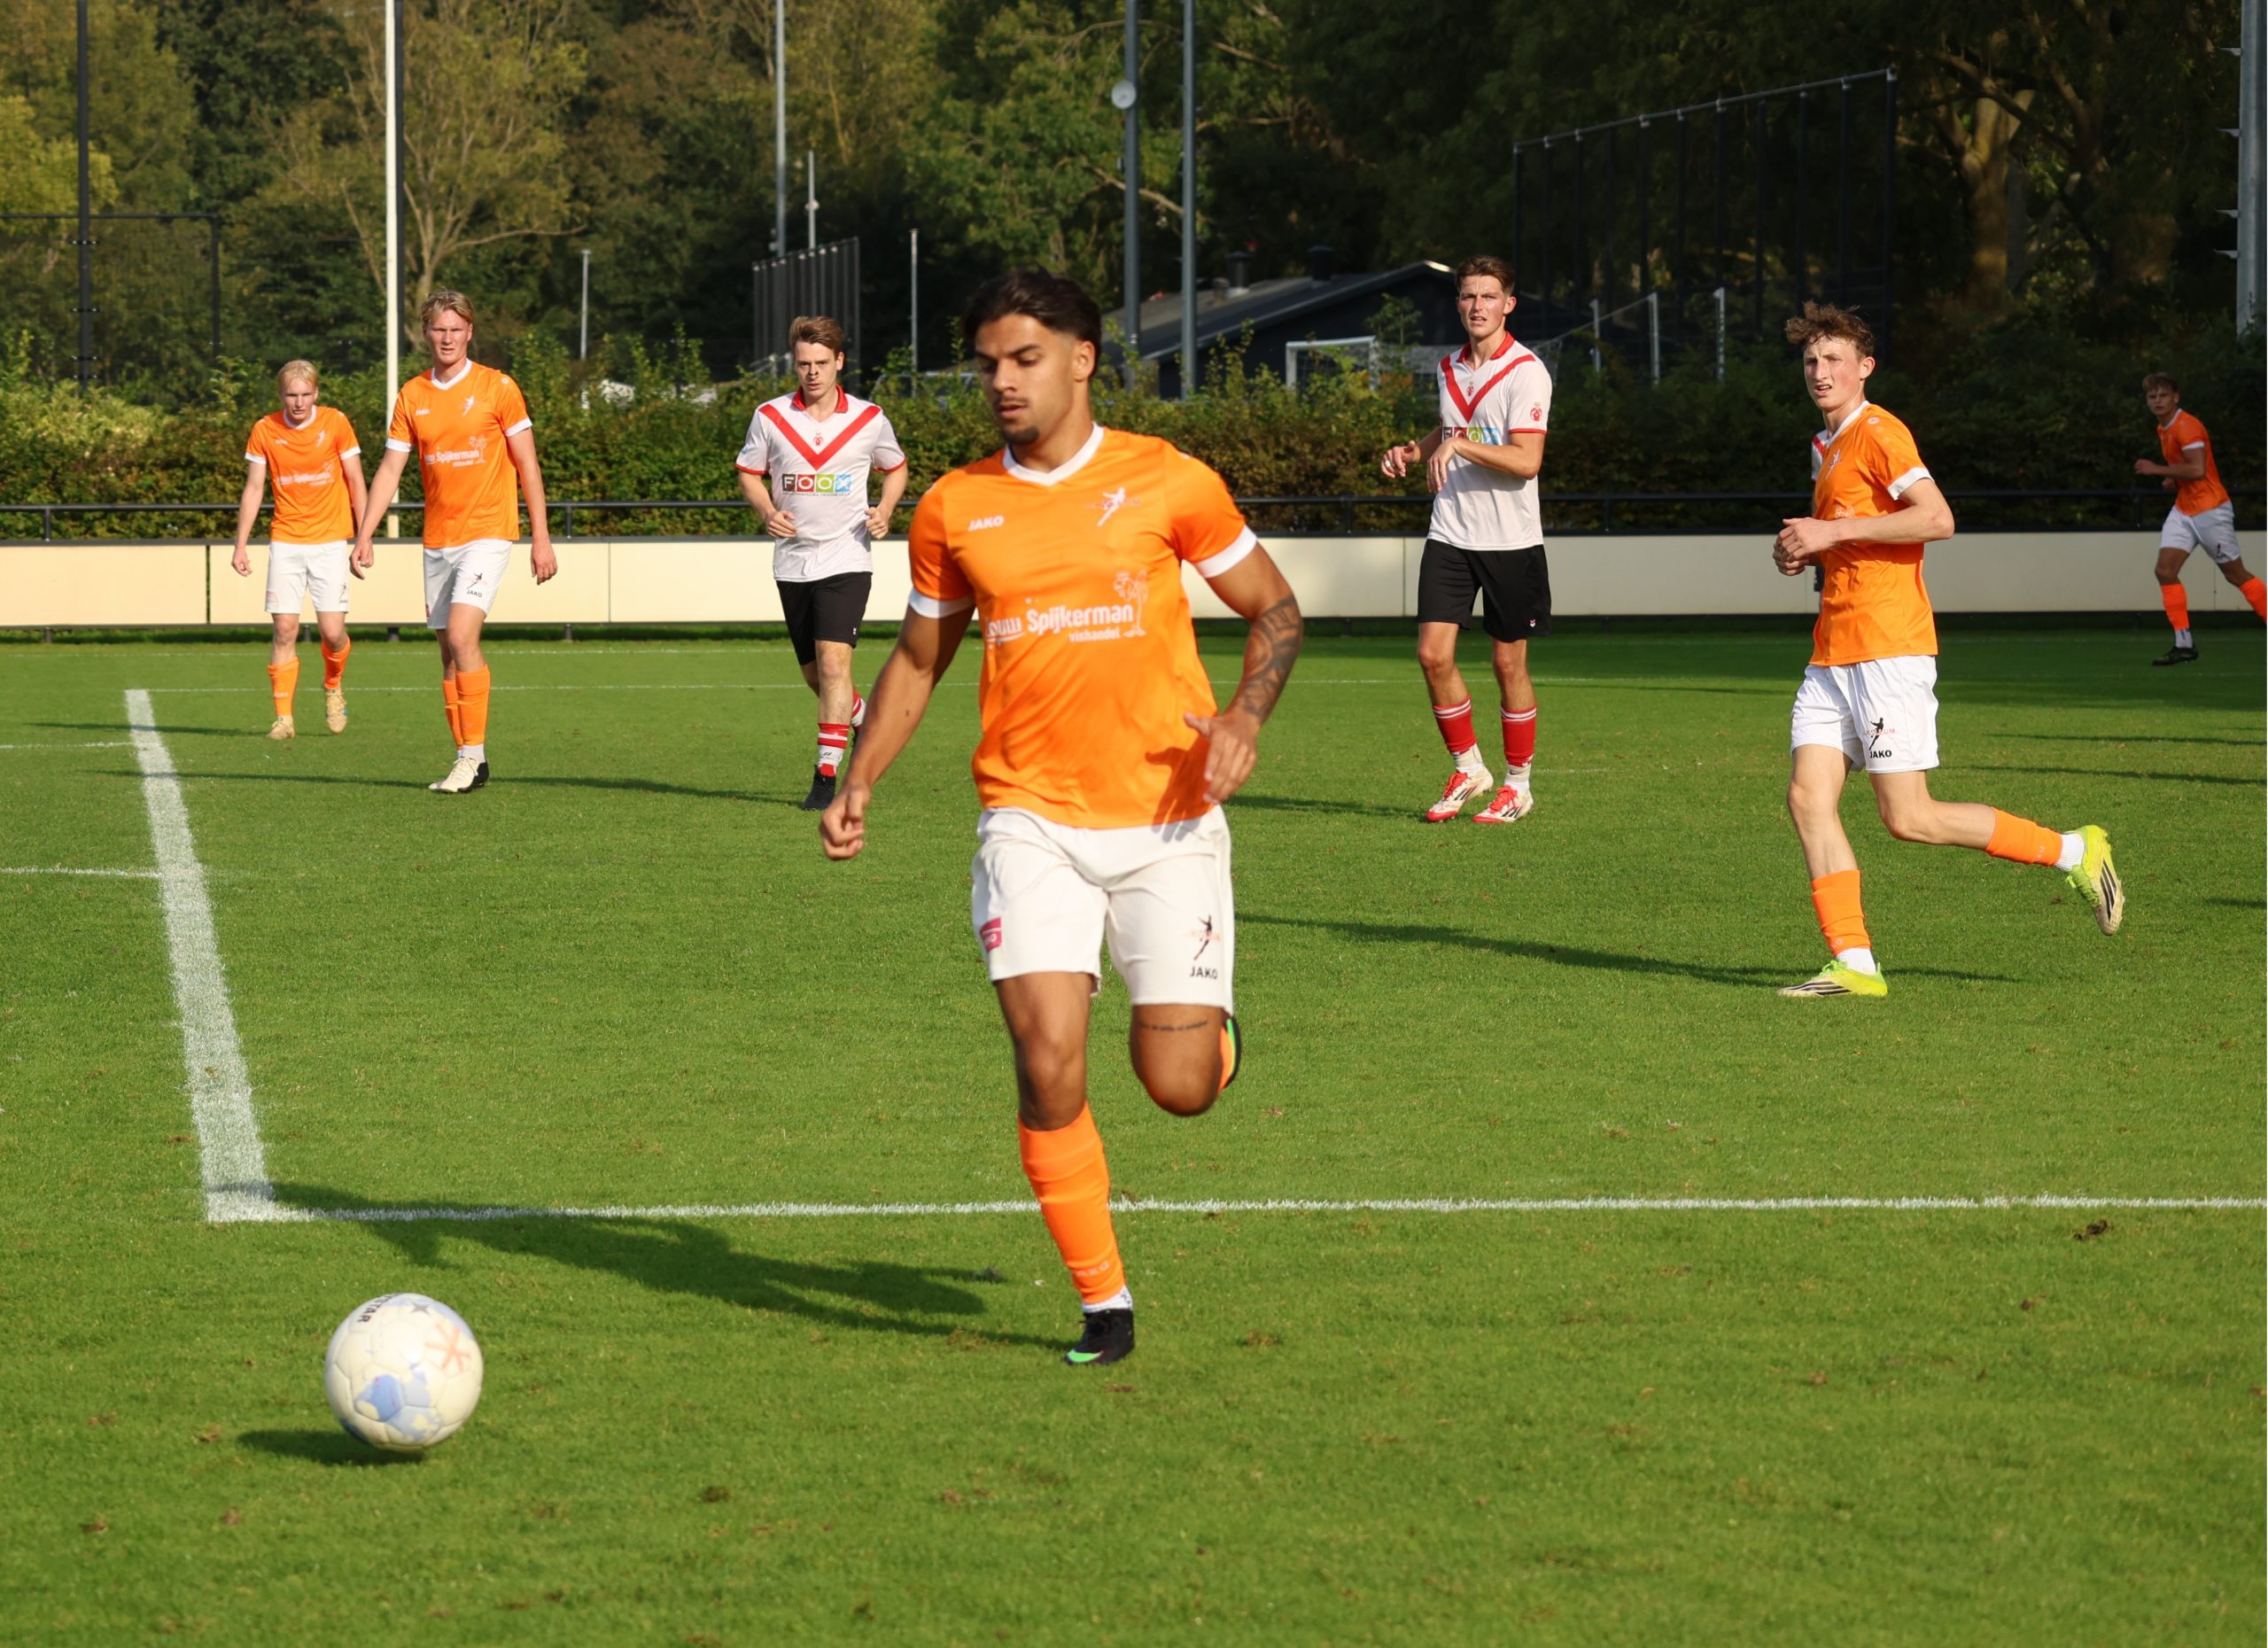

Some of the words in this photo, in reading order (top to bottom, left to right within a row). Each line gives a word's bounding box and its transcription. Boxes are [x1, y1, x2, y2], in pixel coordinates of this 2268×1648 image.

[782, 474, 851, 492] FOOX
[968, 516, 1005, 532] JAKO
[466, 589, 483, 598] JAKO
[1026, 604, 1133, 635] Spijkerman
[1068, 626, 1121, 642] vishandel
[1869, 750, 1892, 759] JAKO
[1190, 966, 1218, 980] JAKO
